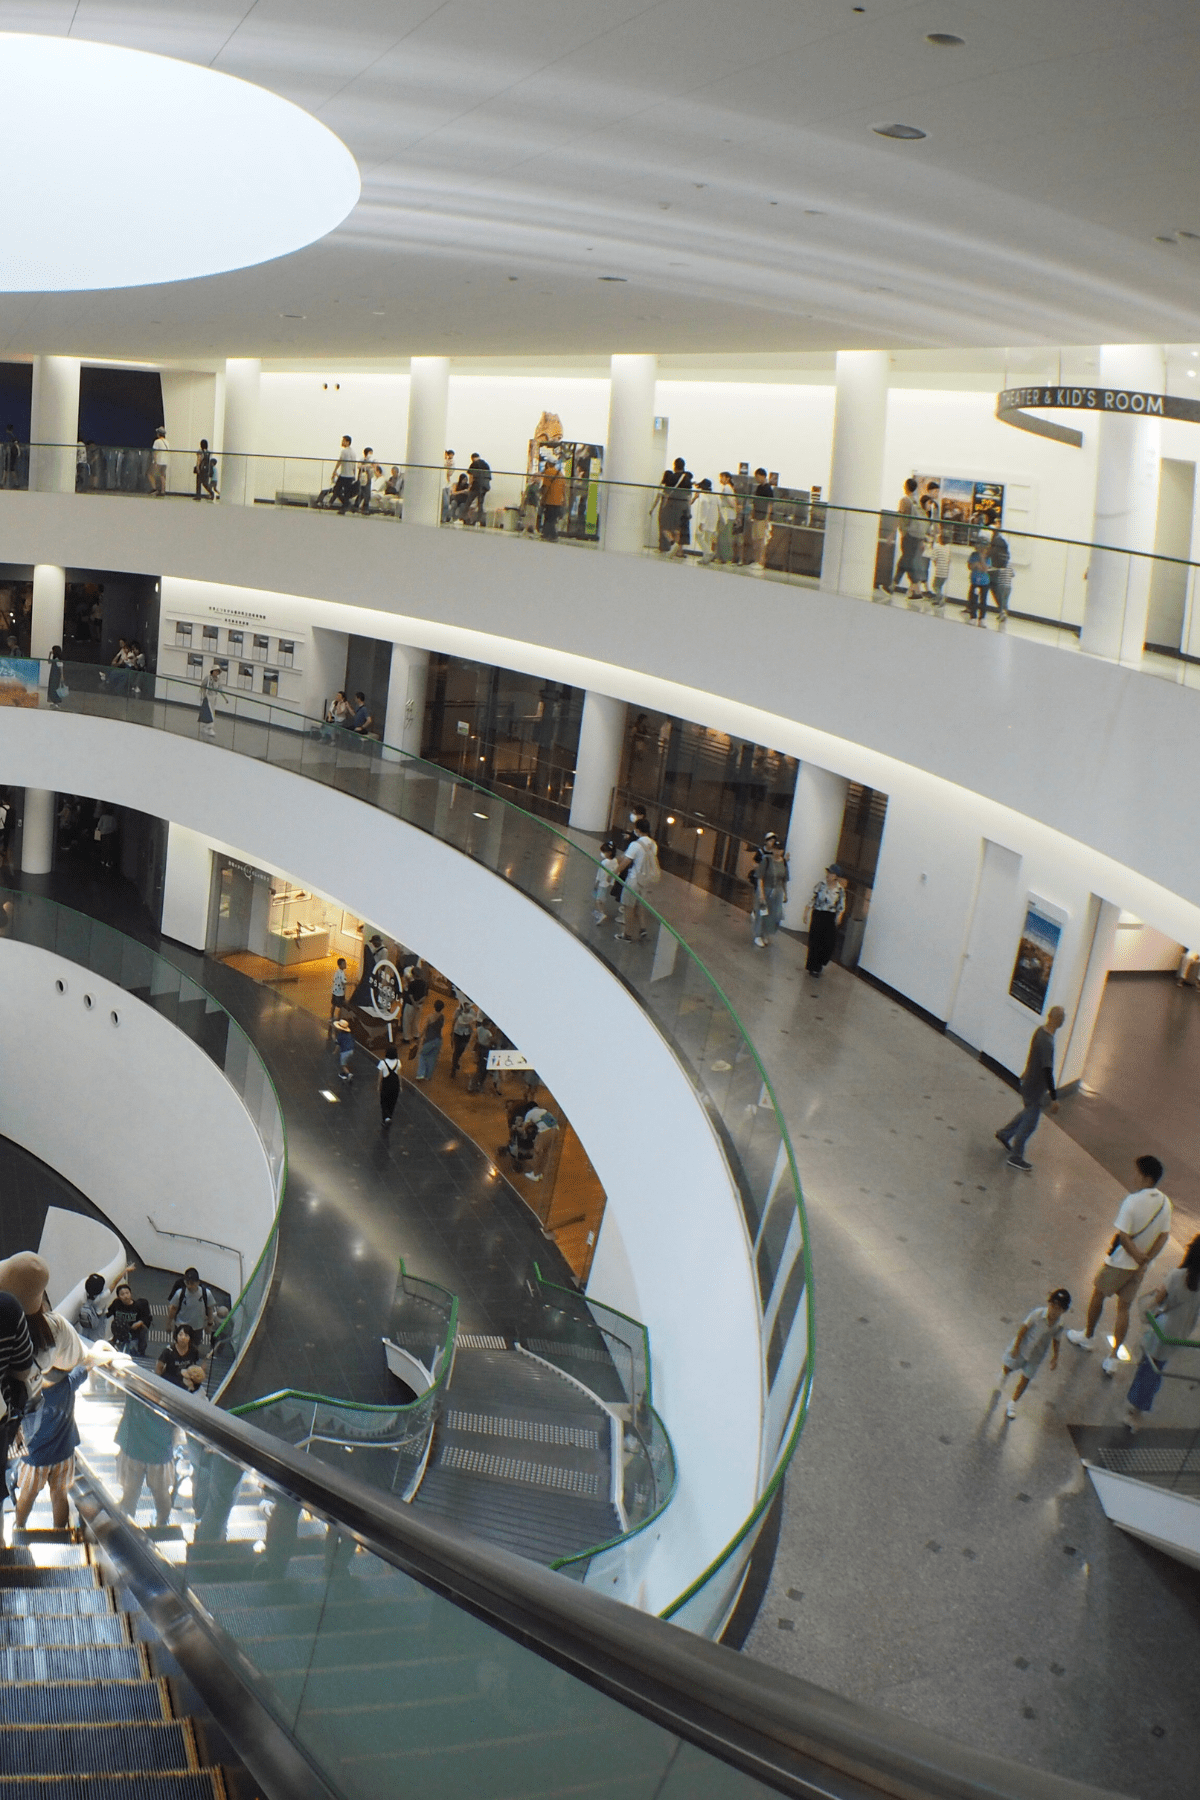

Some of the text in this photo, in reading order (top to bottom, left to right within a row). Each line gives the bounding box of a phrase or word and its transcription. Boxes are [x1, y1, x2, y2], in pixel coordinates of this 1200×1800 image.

[1044, 390, 1052, 404] &
[1056, 389, 1096, 407] KID'S
[1104, 391, 1164, 415] ROOM
